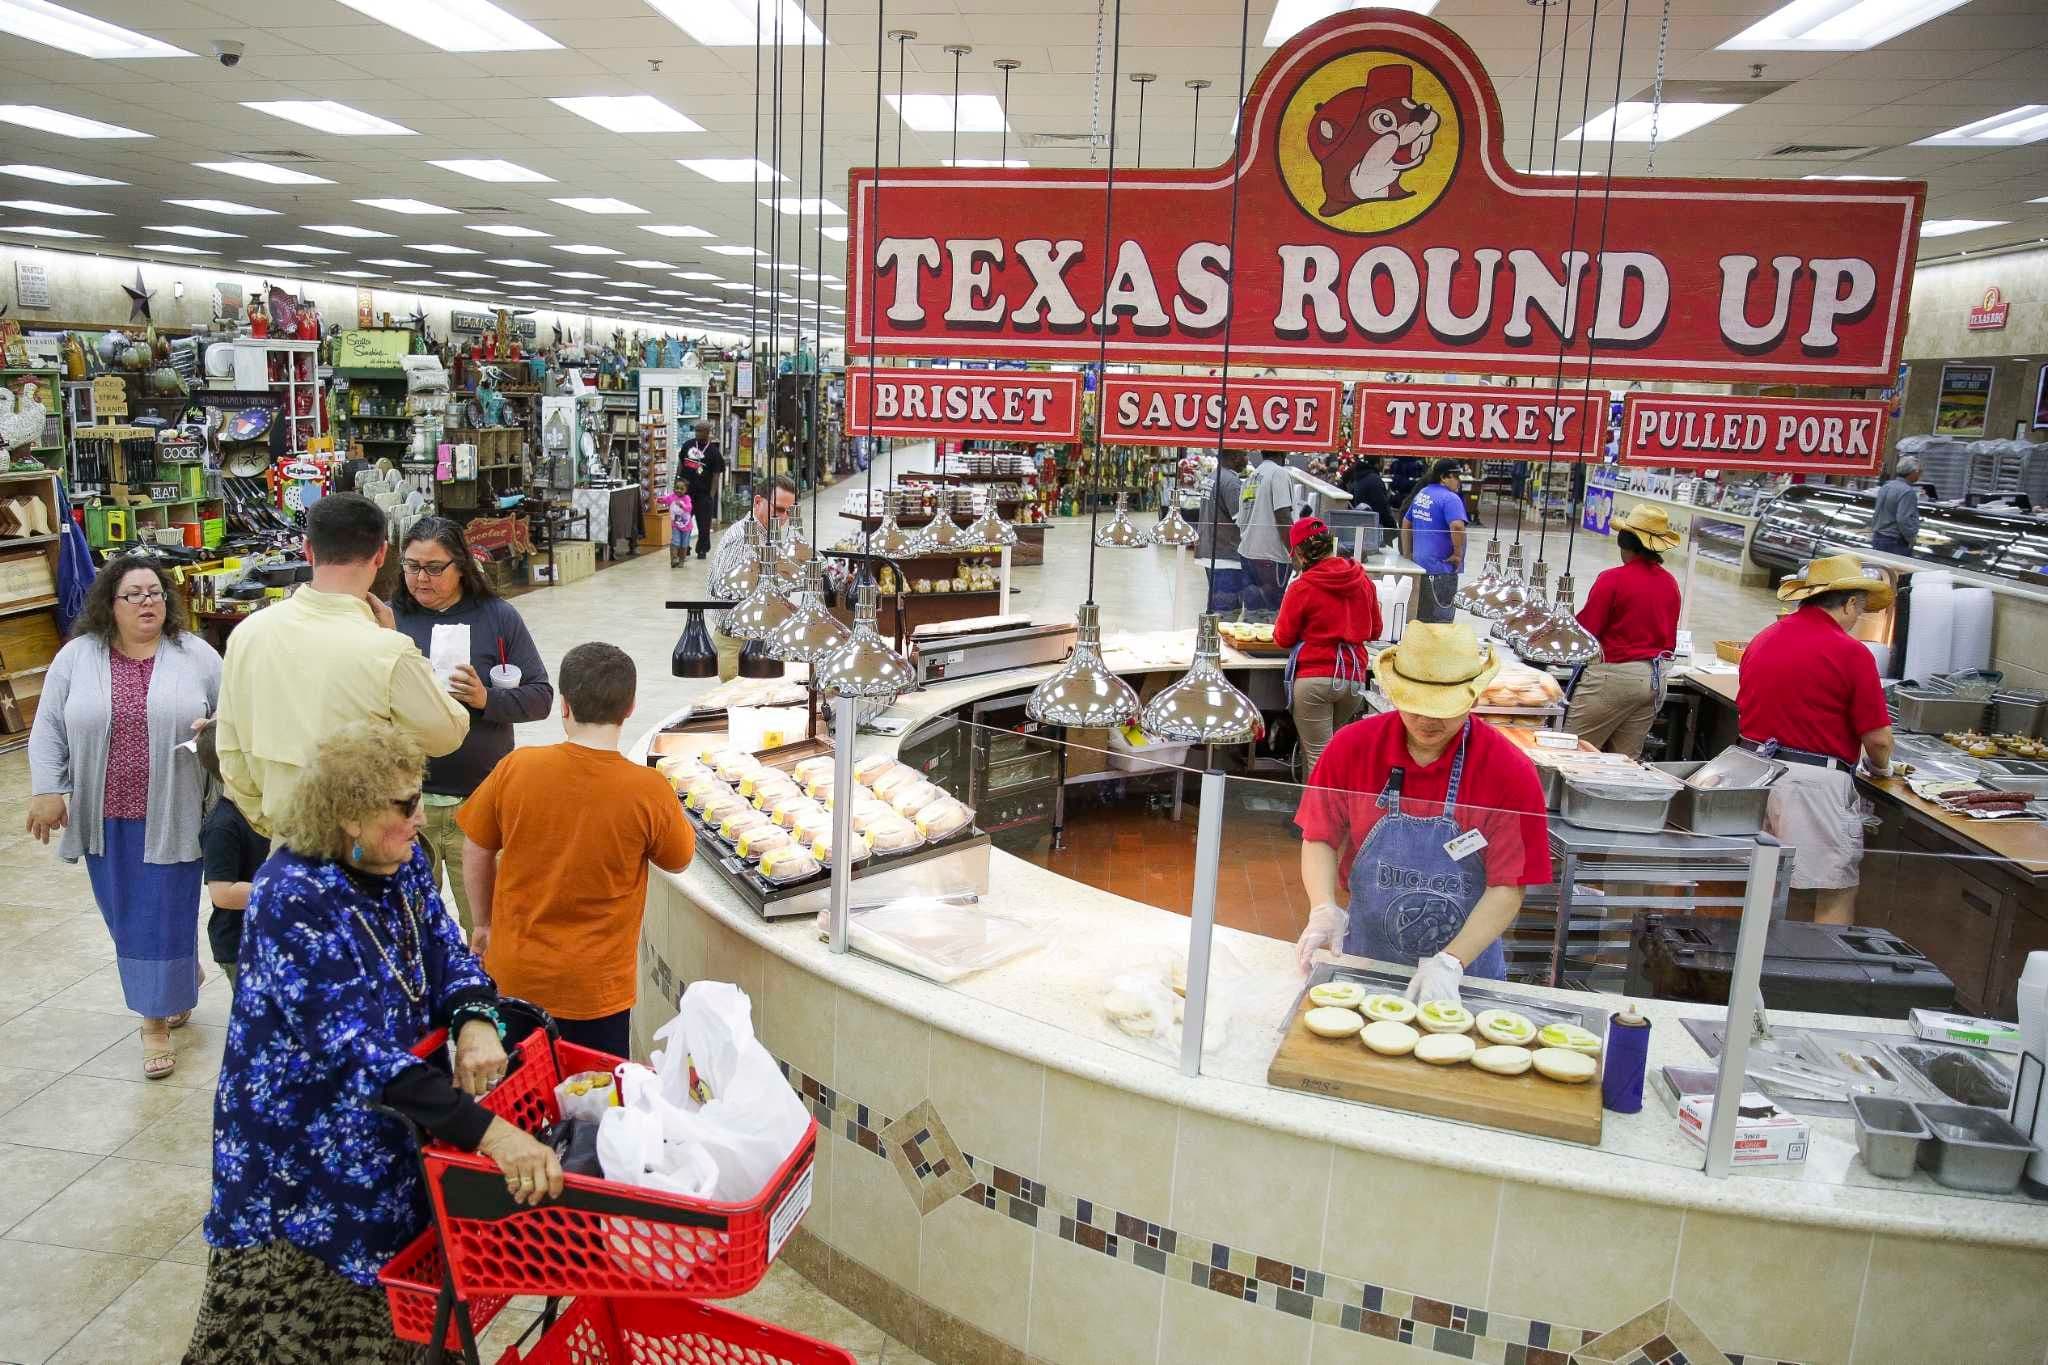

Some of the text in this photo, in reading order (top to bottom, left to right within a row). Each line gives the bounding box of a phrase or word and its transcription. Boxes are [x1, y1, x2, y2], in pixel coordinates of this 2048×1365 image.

[876, 236, 1878, 354] TEXAS ROUND UP
[875, 383, 1054, 424] BRISKET
[1116, 391, 1319, 433] SAUSAGE
[1385, 400, 1577, 443] TURKEY
[162, 445, 198, 460] COOK
[1635, 409, 1871, 457] PULLED PORK
[150, 486, 178, 500] EAT
